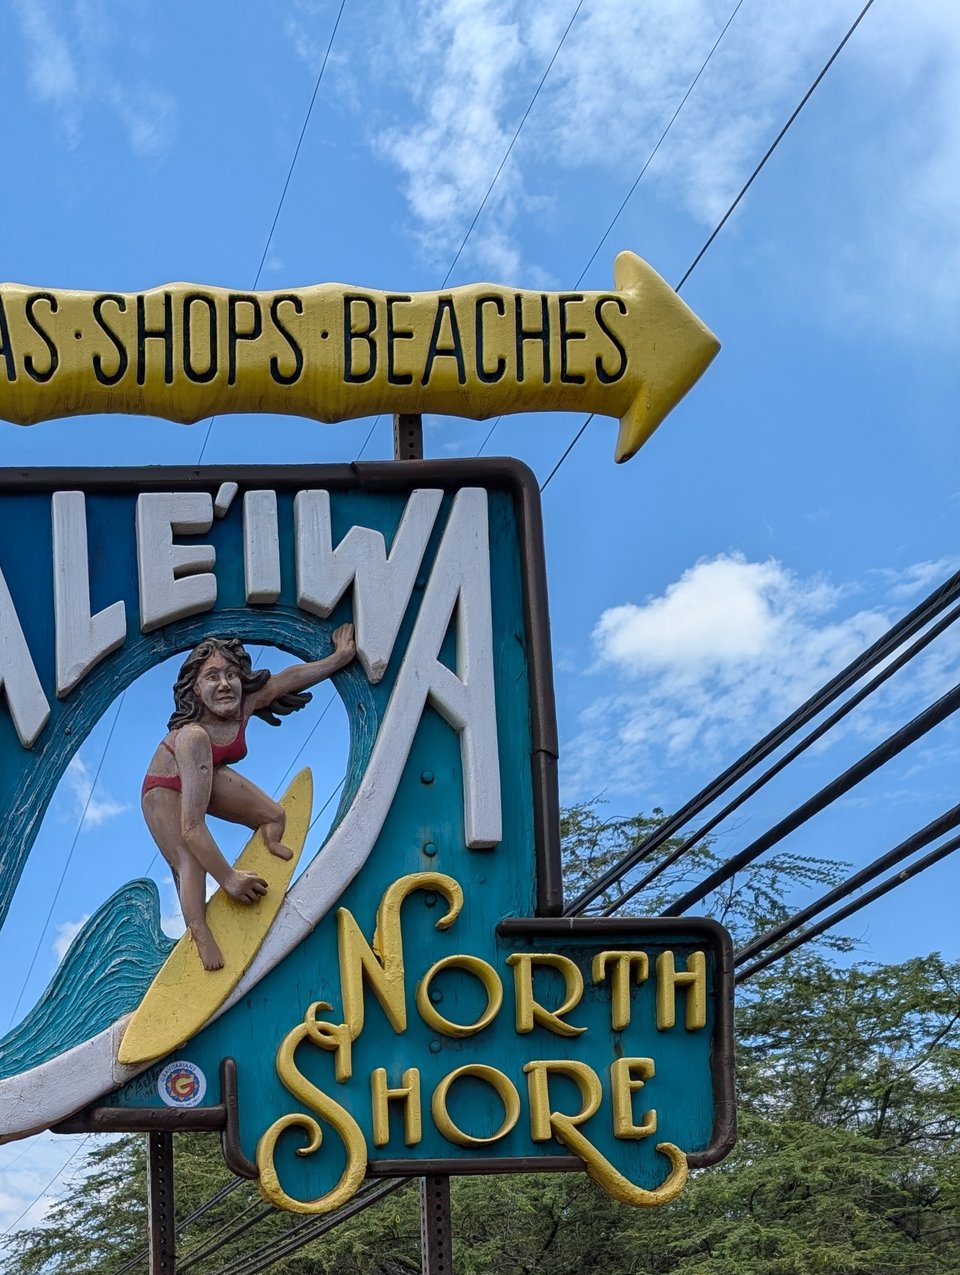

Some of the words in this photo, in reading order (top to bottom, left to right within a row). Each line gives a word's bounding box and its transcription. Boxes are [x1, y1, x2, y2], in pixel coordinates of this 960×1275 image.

[92, 294, 304, 386] SHOPS
[343, 293, 628, 386] BEACHES
[336, 872, 707, 1040] NORTH
[256, 1002, 688, 1215] SHORE
